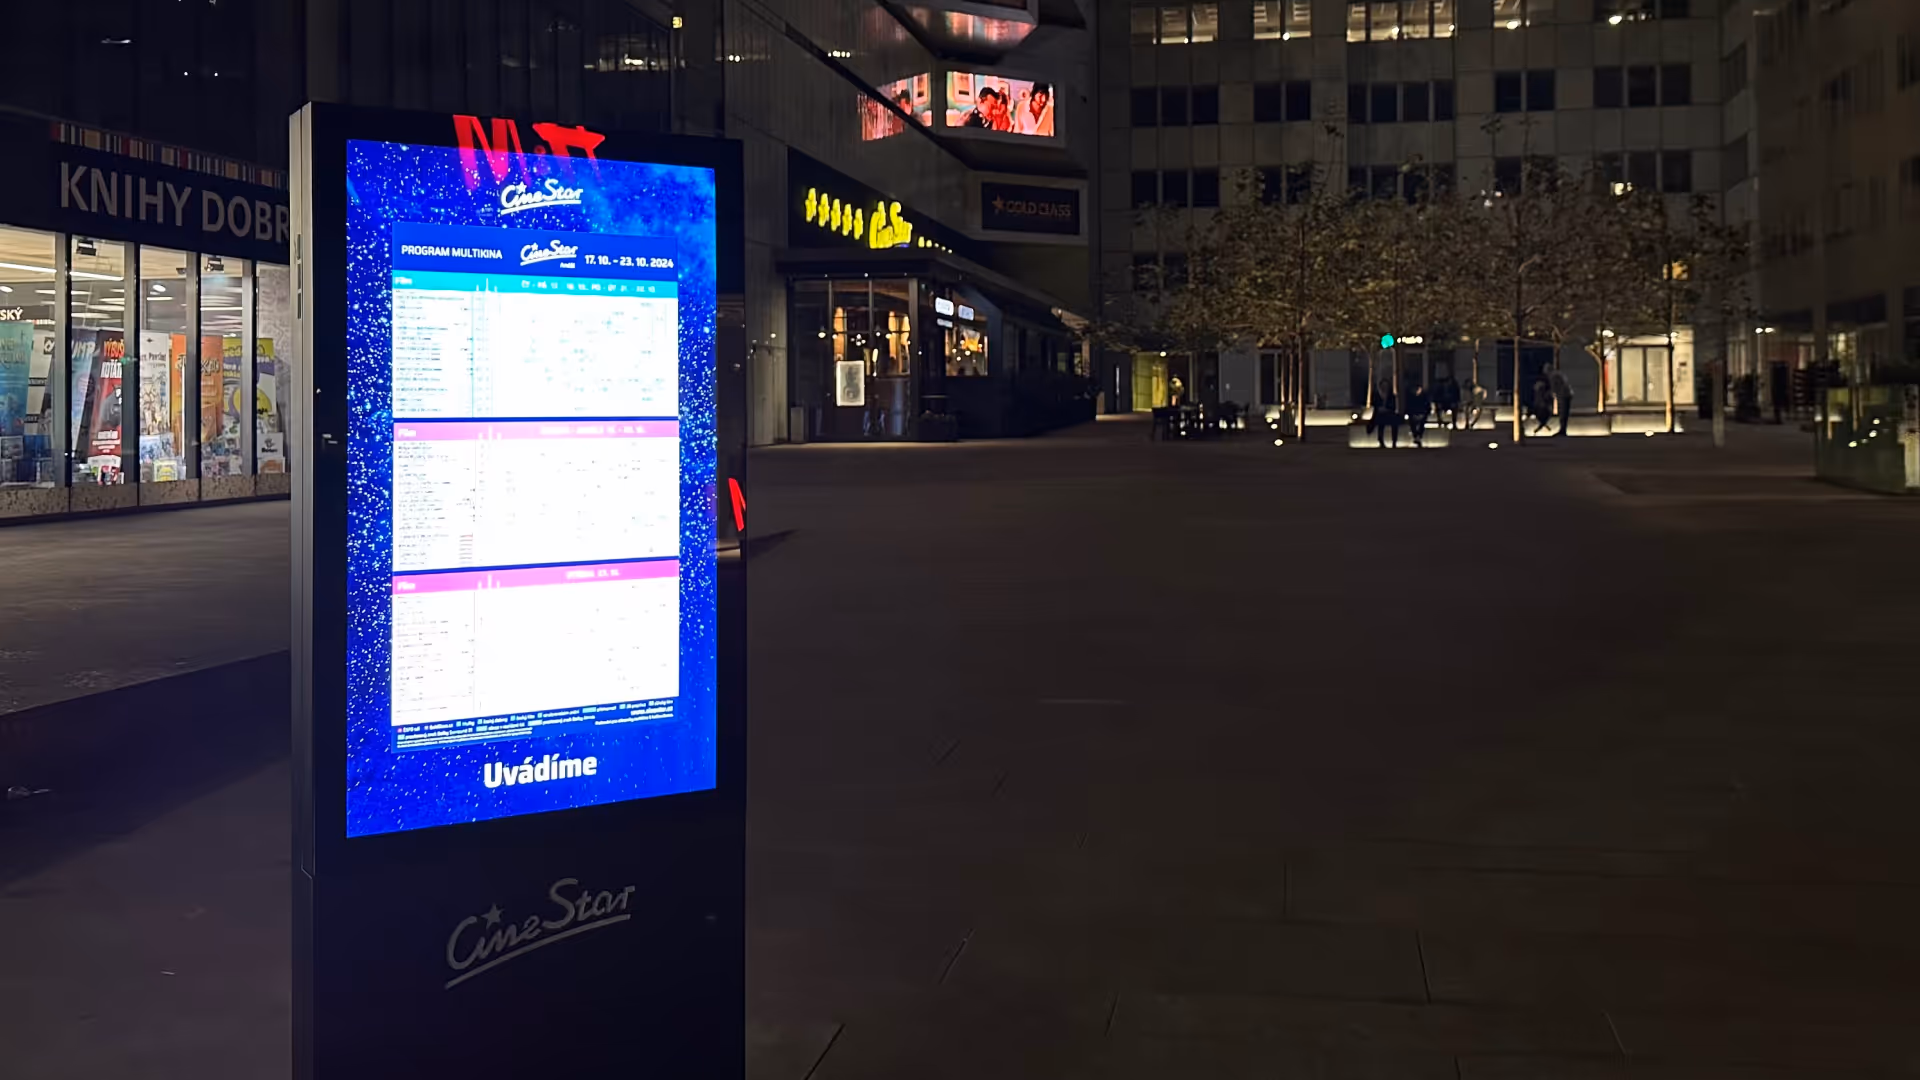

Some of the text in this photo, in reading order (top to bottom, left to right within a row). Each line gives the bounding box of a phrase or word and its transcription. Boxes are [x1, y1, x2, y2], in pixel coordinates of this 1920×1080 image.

[61, 162, 192, 227] KNIHY
[500, 179, 584, 211] CineStar
[401, 244, 503, 260] PROGRAM MULTIKINA
[520, 239, 579, 264] CineStar
[585, 254, 597, 265] 17.
[598, 255, 612, 266] 10.
[620, 256, 635, 267] 23.
[636, 256, 649, 267] 10.
[650, 257, 674, 269] 2024
[484, 753, 598, 788] Uvádíme
[446, 878, 636, 975] CineStar
